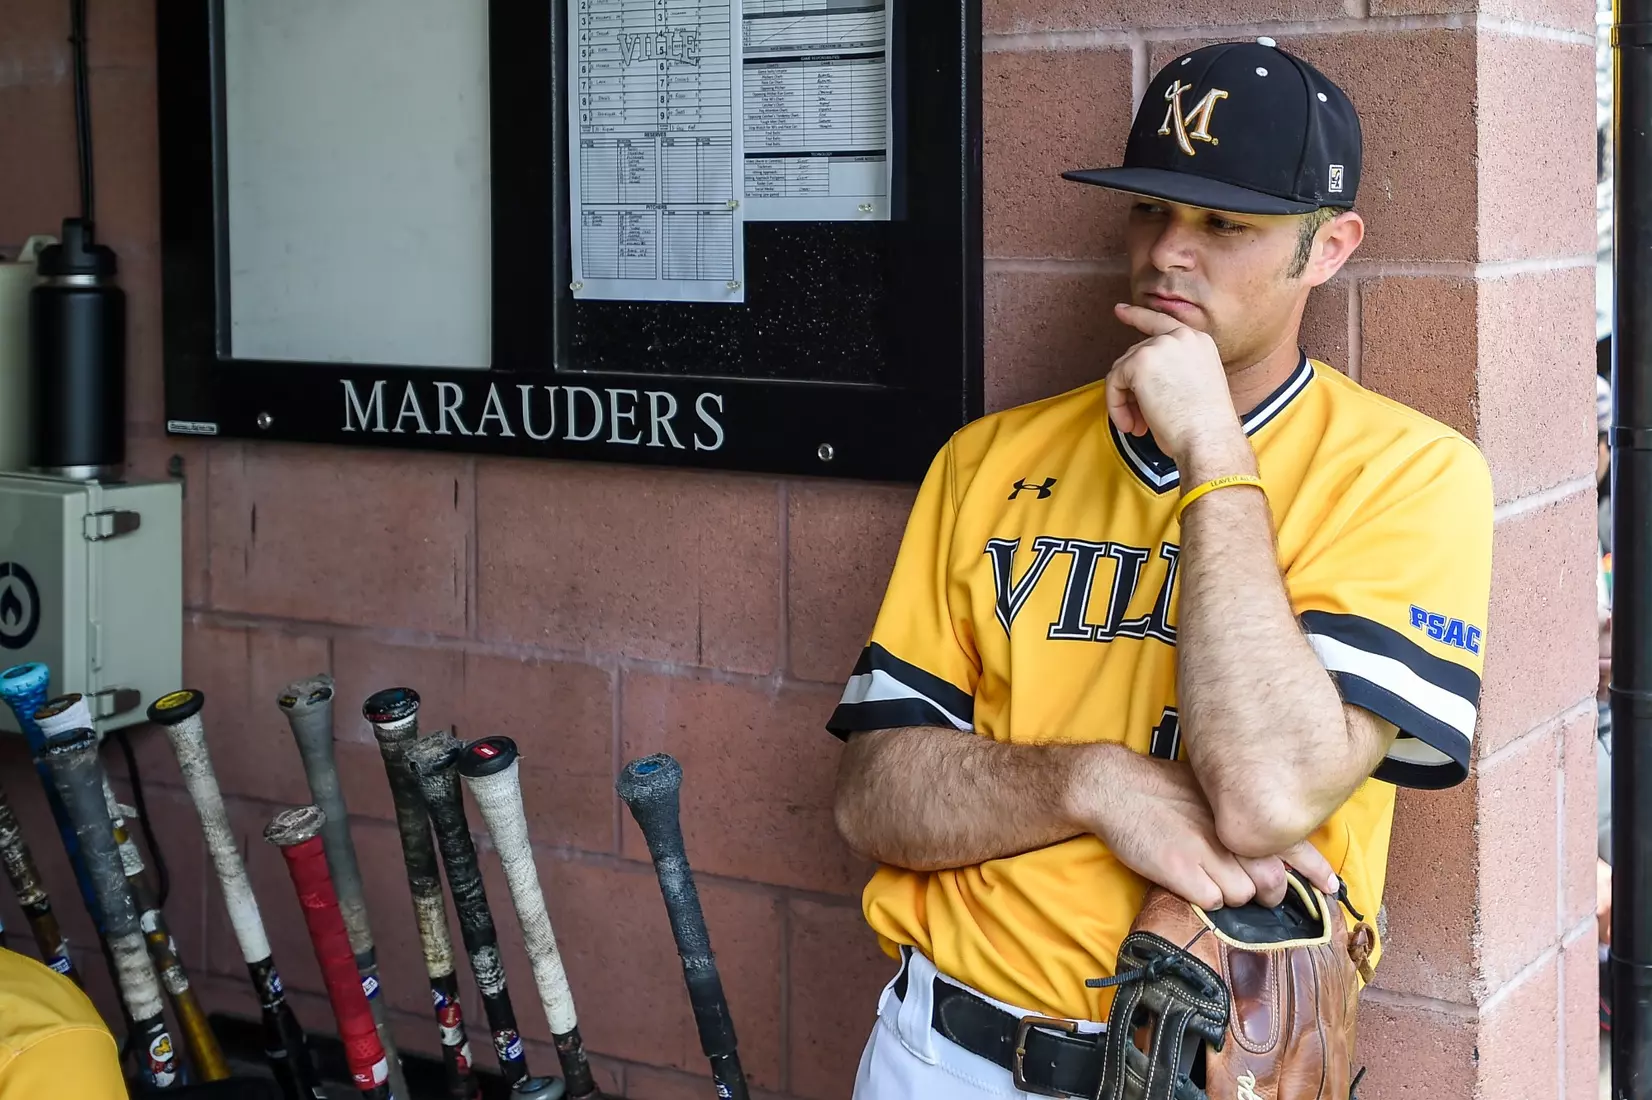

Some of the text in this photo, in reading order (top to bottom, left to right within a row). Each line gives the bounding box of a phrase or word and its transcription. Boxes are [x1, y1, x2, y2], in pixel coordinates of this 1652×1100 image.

[616, 27, 698, 67] VILLE
[340, 379, 725, 451] MARAUDERS
[1210, 477, 1231, 487] LEAVE
[1409, 604, 1482, 657] PSAC
